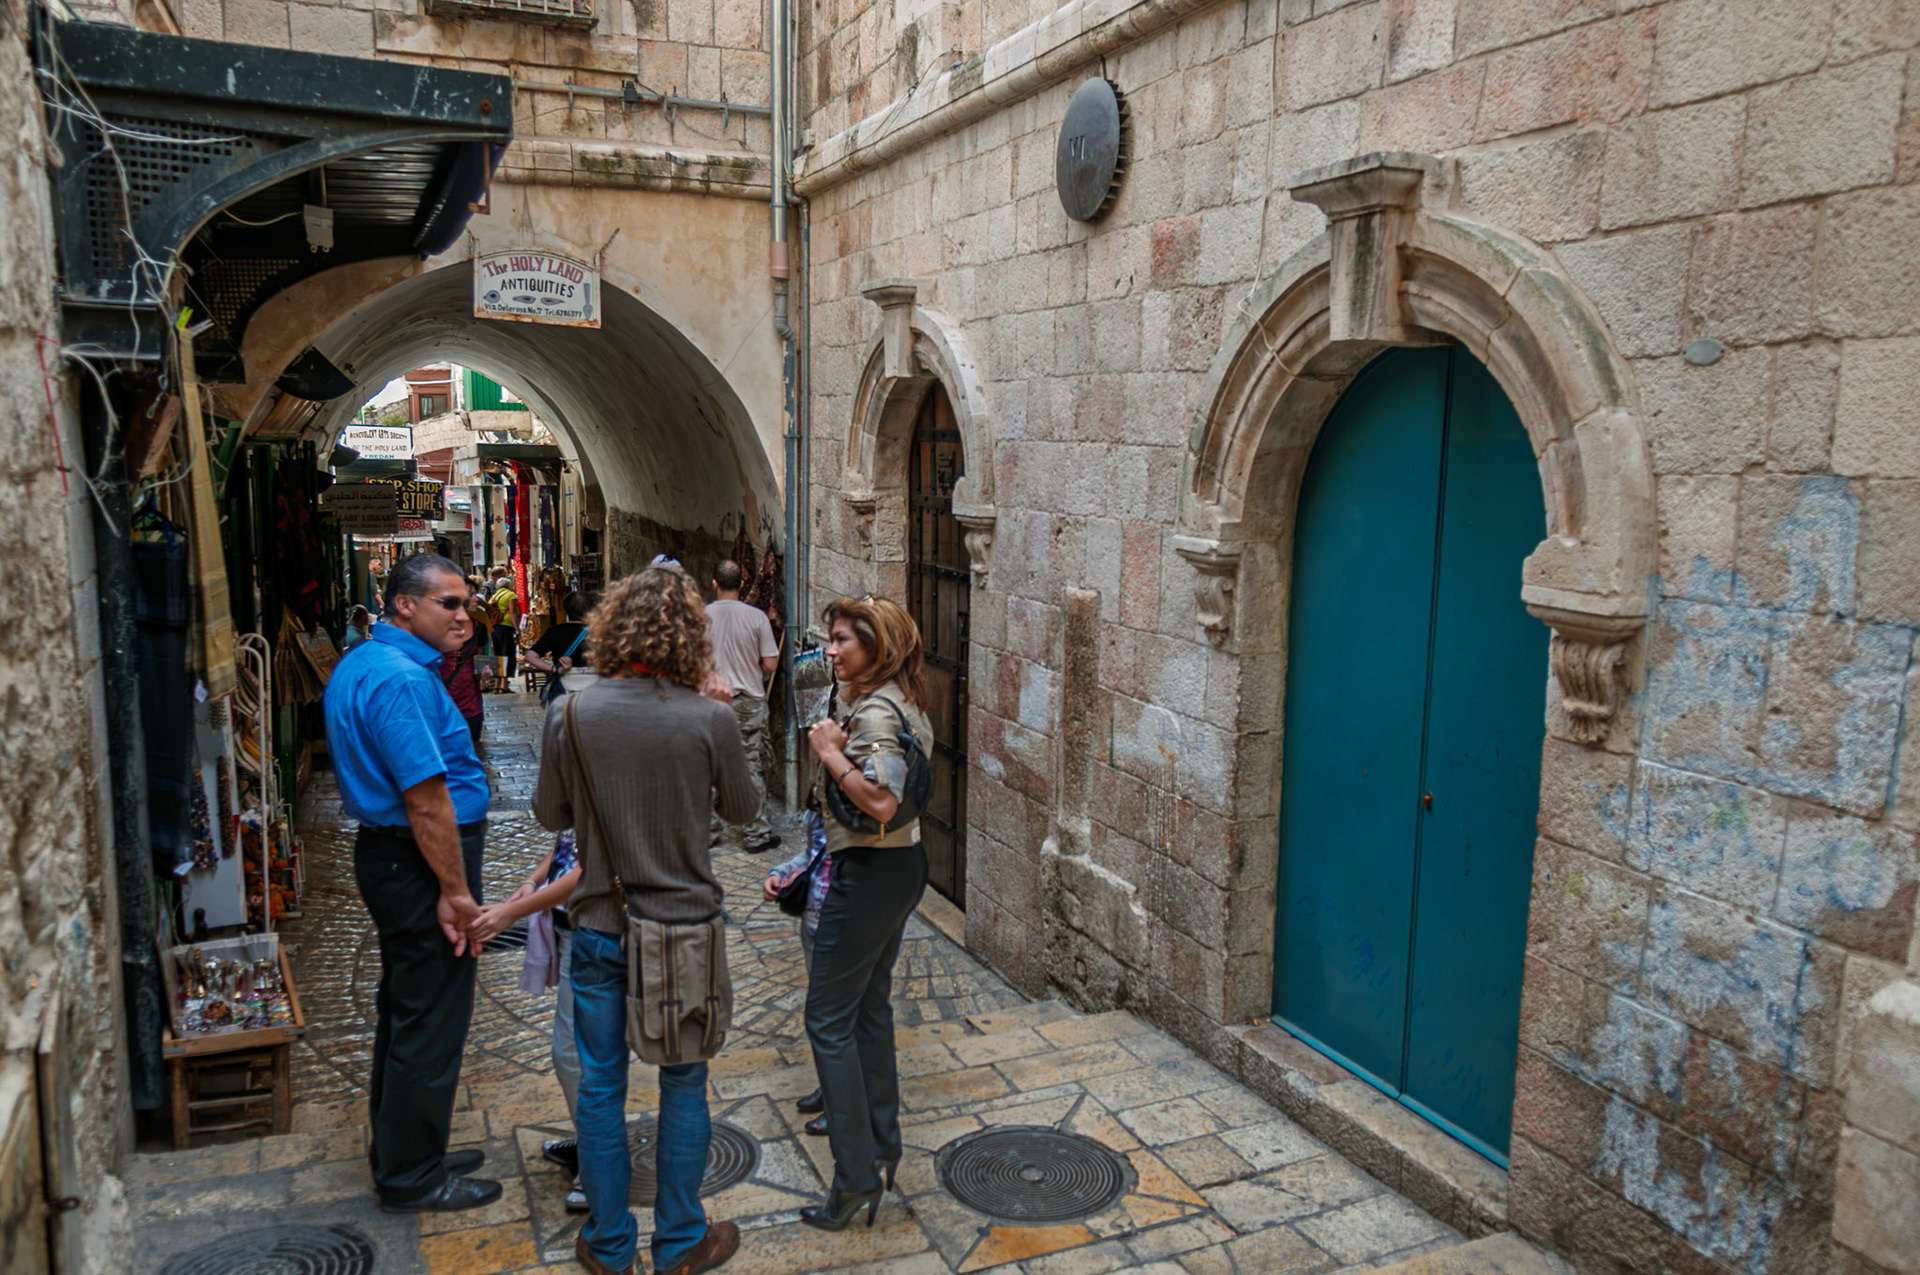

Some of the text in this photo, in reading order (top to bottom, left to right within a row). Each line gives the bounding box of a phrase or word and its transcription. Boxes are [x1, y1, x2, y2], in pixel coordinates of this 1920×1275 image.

[1069, 134, 1085, 160] VI
[482, 256, 584, 284] The HOLY LAND
[500, 278, 575, 298] ANTIQUITIES
[402, 491, 437, 511] STORE
